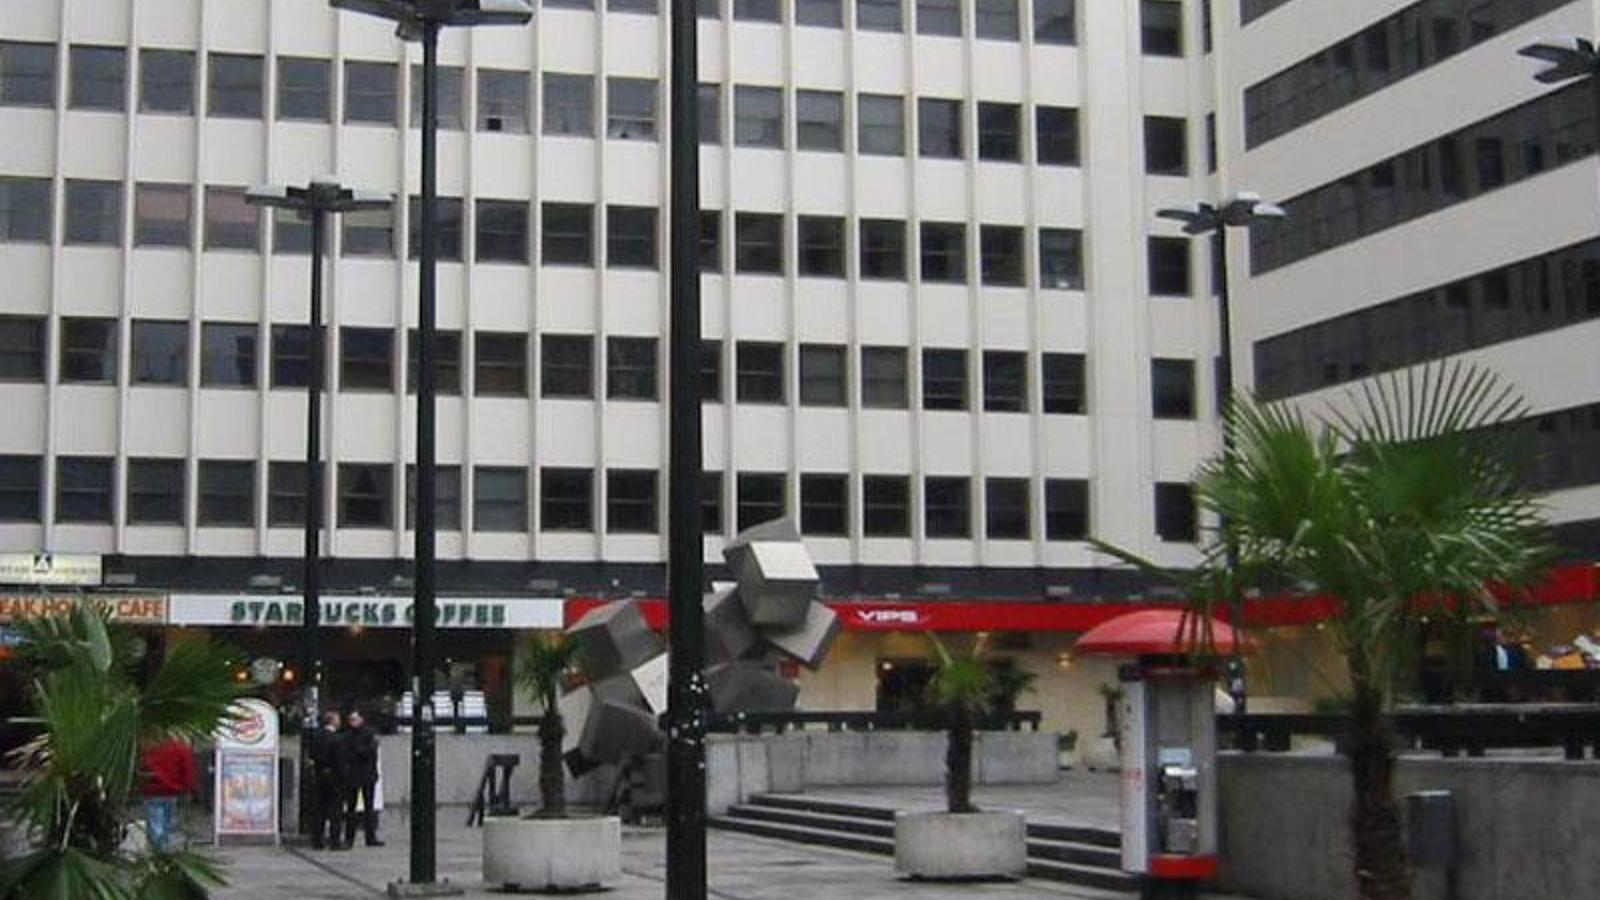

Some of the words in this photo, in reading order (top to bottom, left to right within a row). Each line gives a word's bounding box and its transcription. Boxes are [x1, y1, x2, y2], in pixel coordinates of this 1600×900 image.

[117, 600, 162, 617] CAFE
[231, 601, 396, 624] STARUCKS
[405, 603, 506, 625] CFFEE
